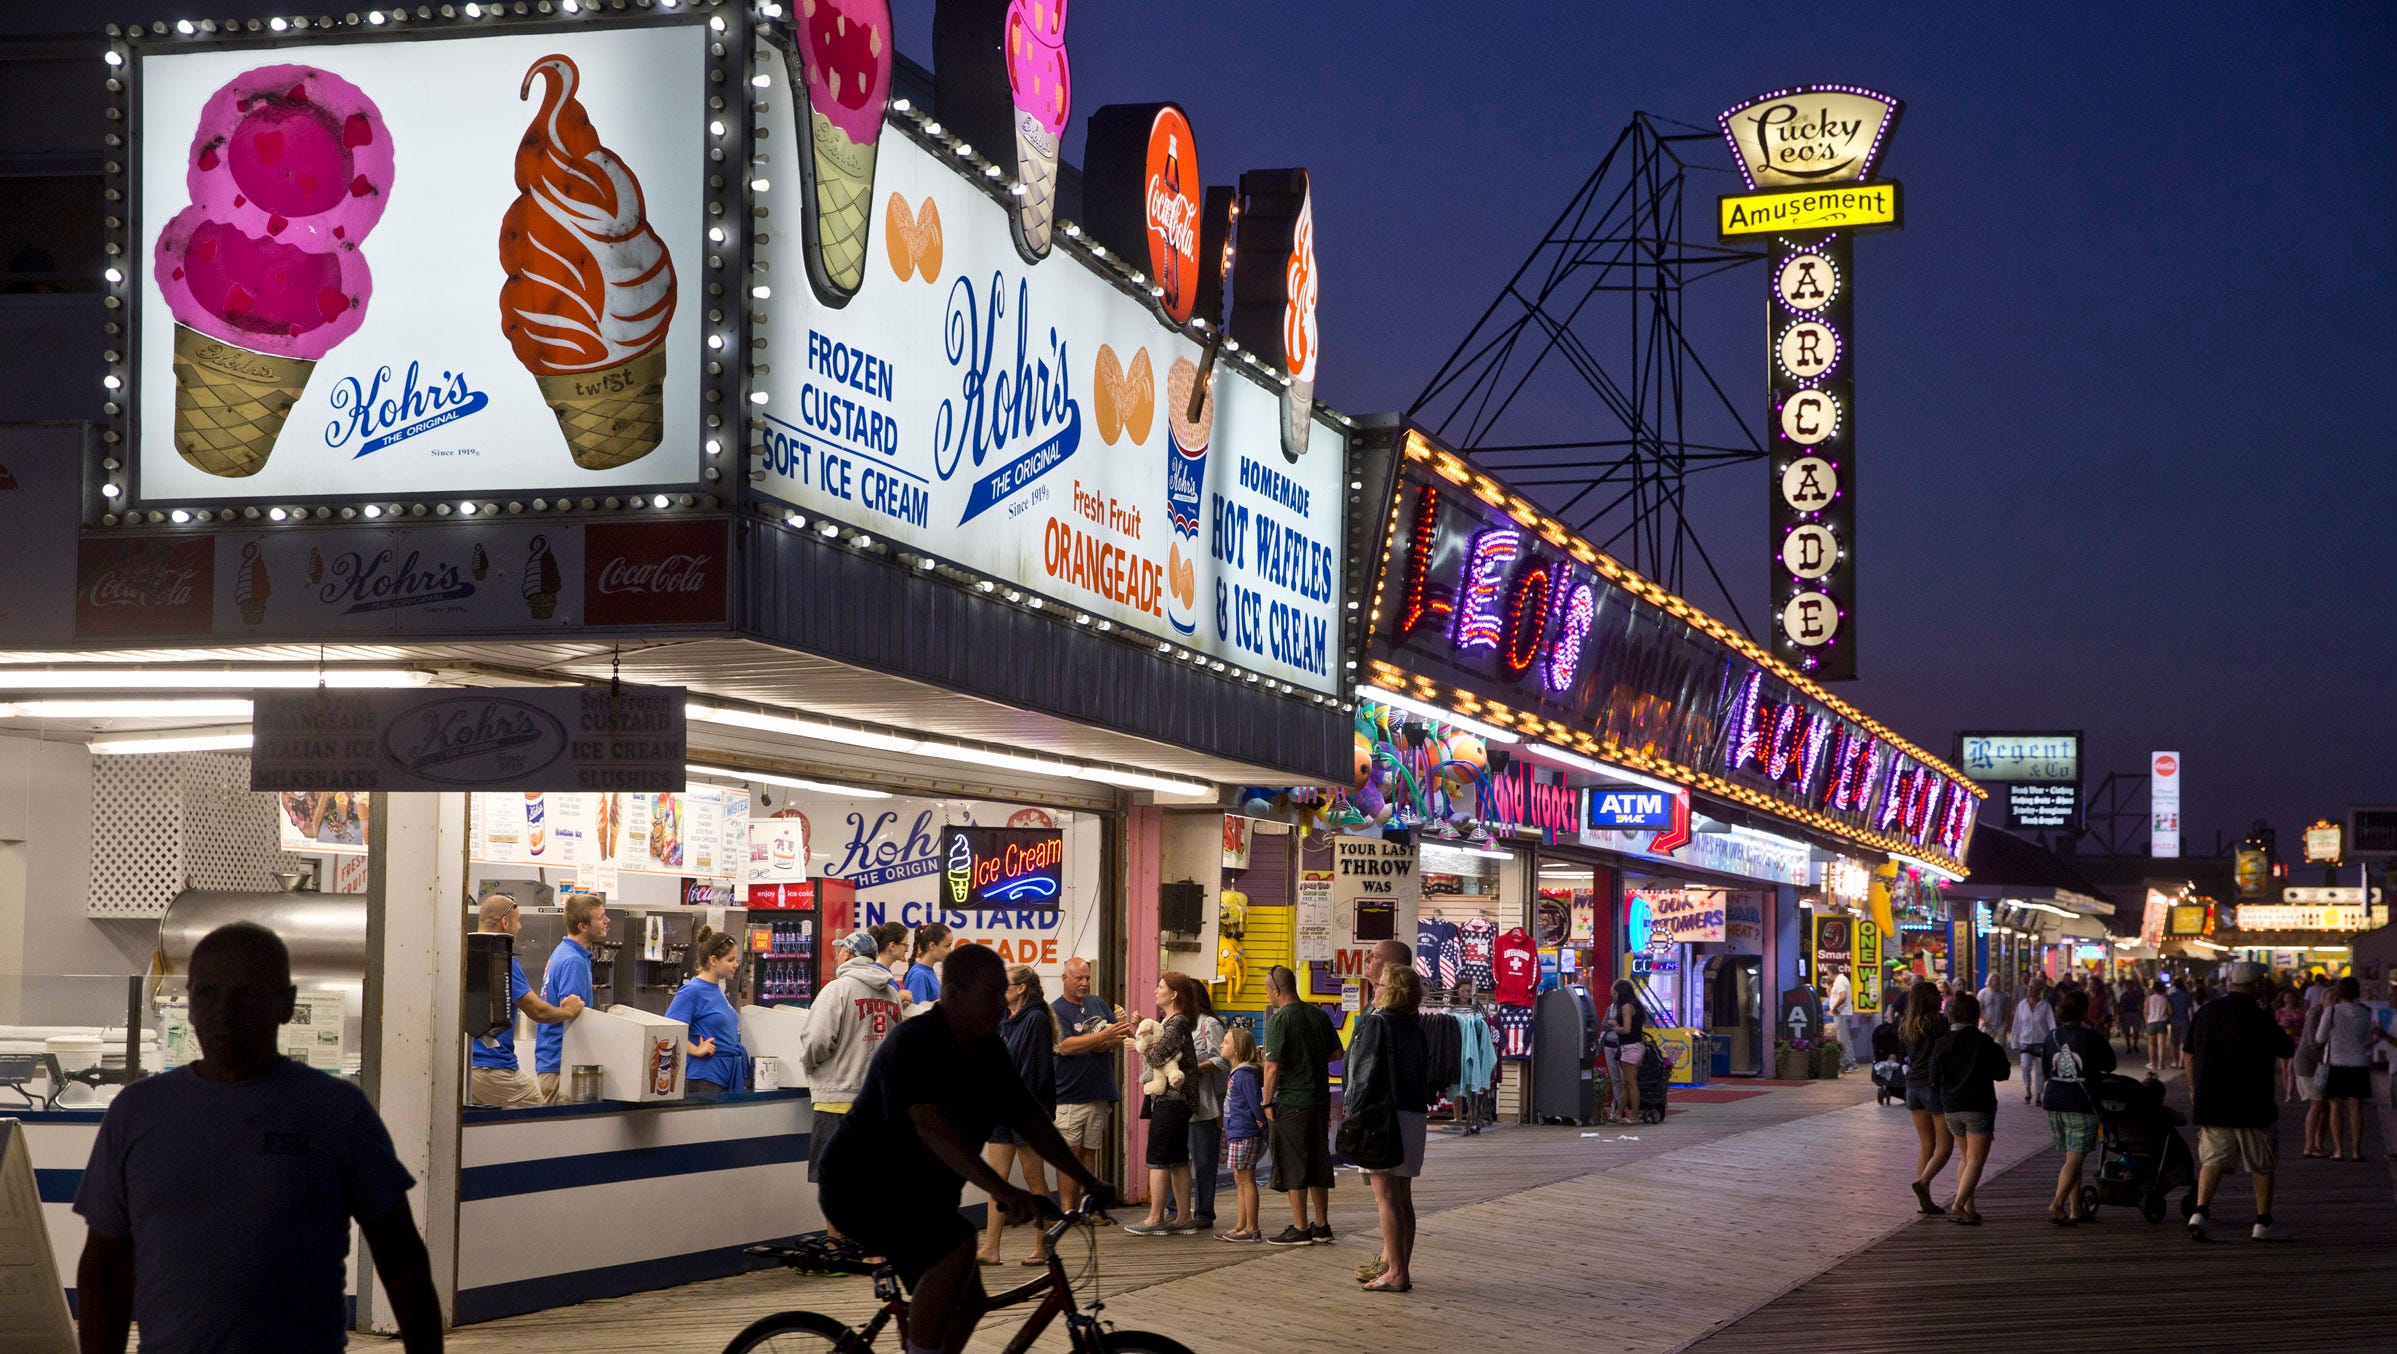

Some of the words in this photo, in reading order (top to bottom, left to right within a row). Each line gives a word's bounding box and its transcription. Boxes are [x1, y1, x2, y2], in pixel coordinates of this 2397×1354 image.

[1729, 191, 1885, 228] Amusement
[807, 329, 893, 402] FROZEN
[934, 269, 1070, 481] Kohr's
[325, 360, 469, 448] Kohr's
[800, 384, 898, 456] CUSTARD
[382, 431, 403, 446] THE
[406, 410, 460, 436] ORIGINAL
[431, 449, 454, 457] Since
[991, 470, 1013, 495] THE
[1014, 439, 1062, 487] ORIGINAL
[1790, 262, 1827, 637] ARCADE
[762, 426, 812, 484] SOFT
[820, 450, 852, 500] ICE
[861, 467, 929, 528] CREAM
[1240, 455, 1310, 518] HOMEMADE
[1008, 496, 1029, 520] Since
[1072, 479, 1106, 525] Fresh
[1109, 499, 1141, 540] Fruit
[1044, 516, 1163, 618] ORANGEADE
[1212, 492, 1248, 570] HOT
[1256, 513, 1332, 605] WAFFLES
[320, 550, 459, 604] Kohr's
[599, 554, 712, 594] Coca-Cola
[1216, 576, 1228, 642] &
[1234, 584, 1263, 655] ICE
[1269, 599, 1328, 677] CREAM
[411, 702, 535, 757] Kohr's
[581, 713, 670, 731] CUSTARD
[345, 741, 377, 759] ICE
[571, 742, 604, 760] ICE
[612, 742, 679, 760] CREAM
[1969, 740, 2070, 768] Regent
[578, 770, 673, 788] SLUSHIES
[2029, 764, 2041, 777] &
[1600, 795, 1661, 814] ATM
[973, 853, 1000, 890] Ice
[1006, 838, 1062, 879] Cream
[1339, 843, 1376, 856] YOUR
[1382, 844, 1415, 856] LAST
[1341, 858, 1413, 876] THROW
[886, 861, 939, 881] ORIGIN
[1362, 881, 1392, 893] WAS
[757, 890, 775, 898] enjoy
[901, 901, 1059, 930] CUSTARD
[1818, 950, 1850, 959] Smart
[1859, 921, 1876, 962] ONE
[1858, 966, 1878, 1009] WIN
[873, 1014, 886, 1033] 8
